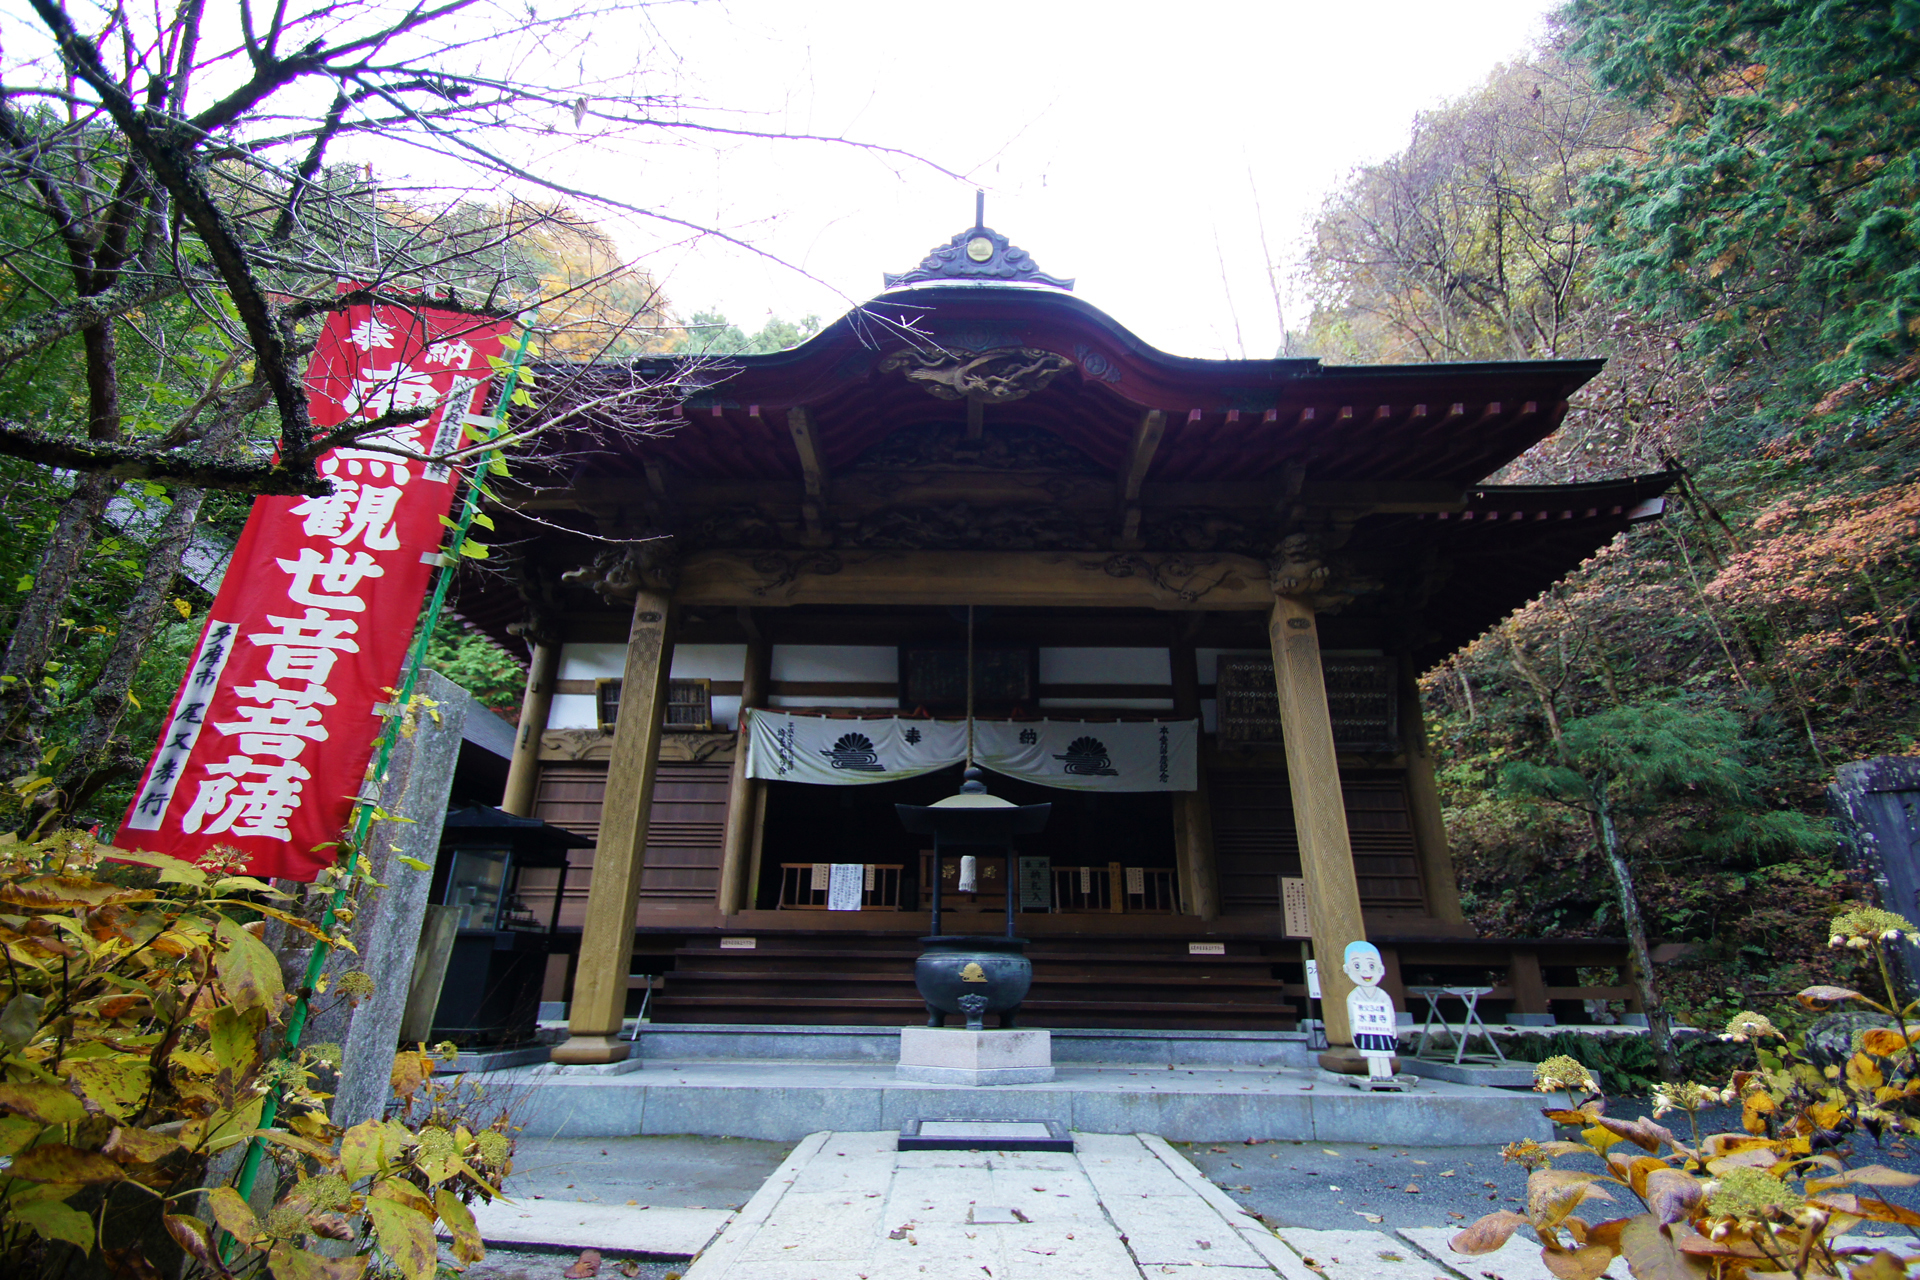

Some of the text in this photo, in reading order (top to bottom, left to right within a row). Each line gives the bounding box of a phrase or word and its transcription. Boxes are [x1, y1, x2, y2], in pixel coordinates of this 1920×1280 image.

[344, 316, 474, 370] 奉 納
[182, 360, 440, 844] 南無観世音菩薩
[195, 623, 232, 688] 多摩市
[904, 726, 1038, 746] 奉 納
